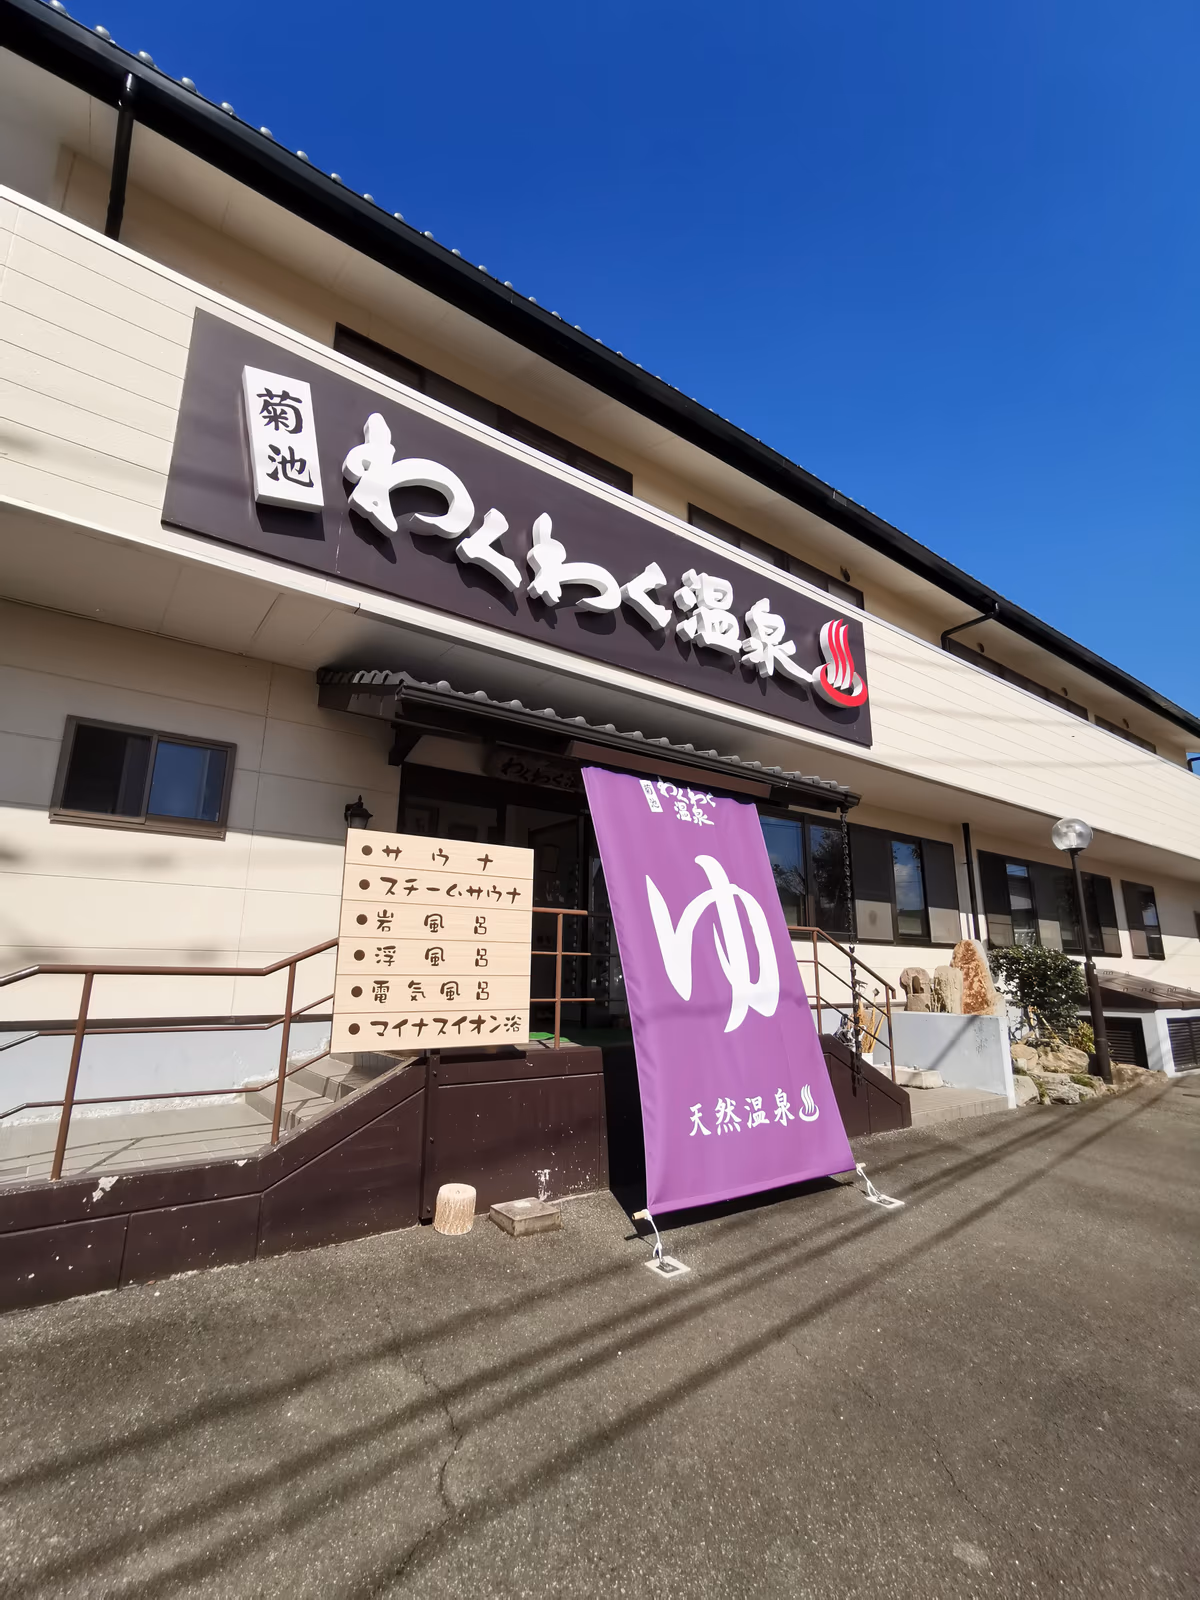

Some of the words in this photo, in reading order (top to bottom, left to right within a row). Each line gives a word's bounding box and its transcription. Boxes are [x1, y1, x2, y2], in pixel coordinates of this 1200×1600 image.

[256, 387, 314, 488] 菊池
[342, 412, 818, 684] わくわく温泉
[657, 776, 716, 807] わくわく
[673, 801, 715, 826] 温泉
[382, 845, 493, 871] サウナ
[379, 876, 522, 904] スチームサウナ
[376, 909, 488, 935] 岩風呂
[374, 945, 489, 967] 浮風呂
[645, 854, 780, 1033] ゆ
[372, 980, 490, 1004] 電気風呂
[370, 1014, 522, 1037] マイナスイオン浴
[689, 1087, 796, 1137] 天然温泉
